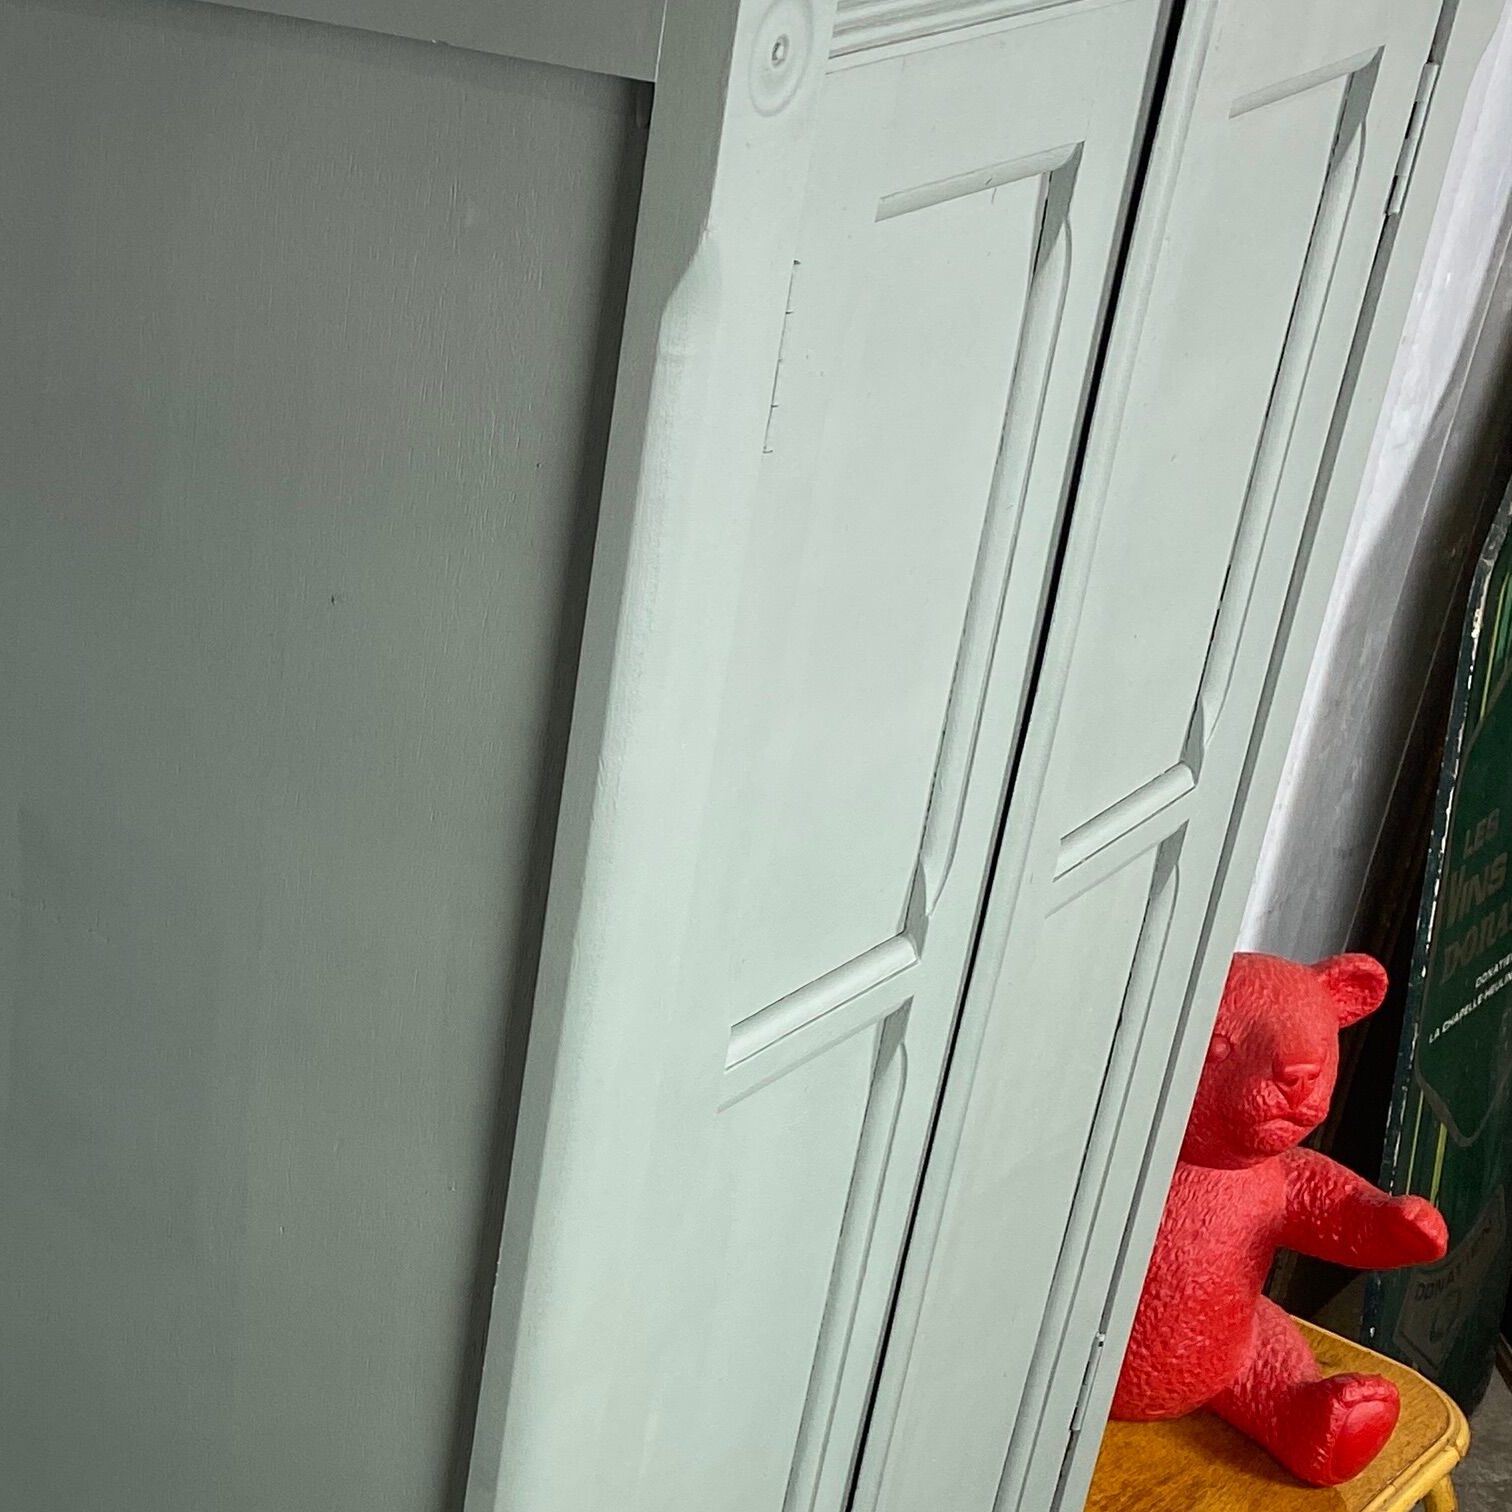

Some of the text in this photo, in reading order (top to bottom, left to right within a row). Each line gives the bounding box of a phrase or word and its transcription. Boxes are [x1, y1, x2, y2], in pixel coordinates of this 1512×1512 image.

[1448, 852, 1508, 927] VINS
[1440, 897, 1512, 984] DONA
[1428, 1028, 1440, 1044] LA
